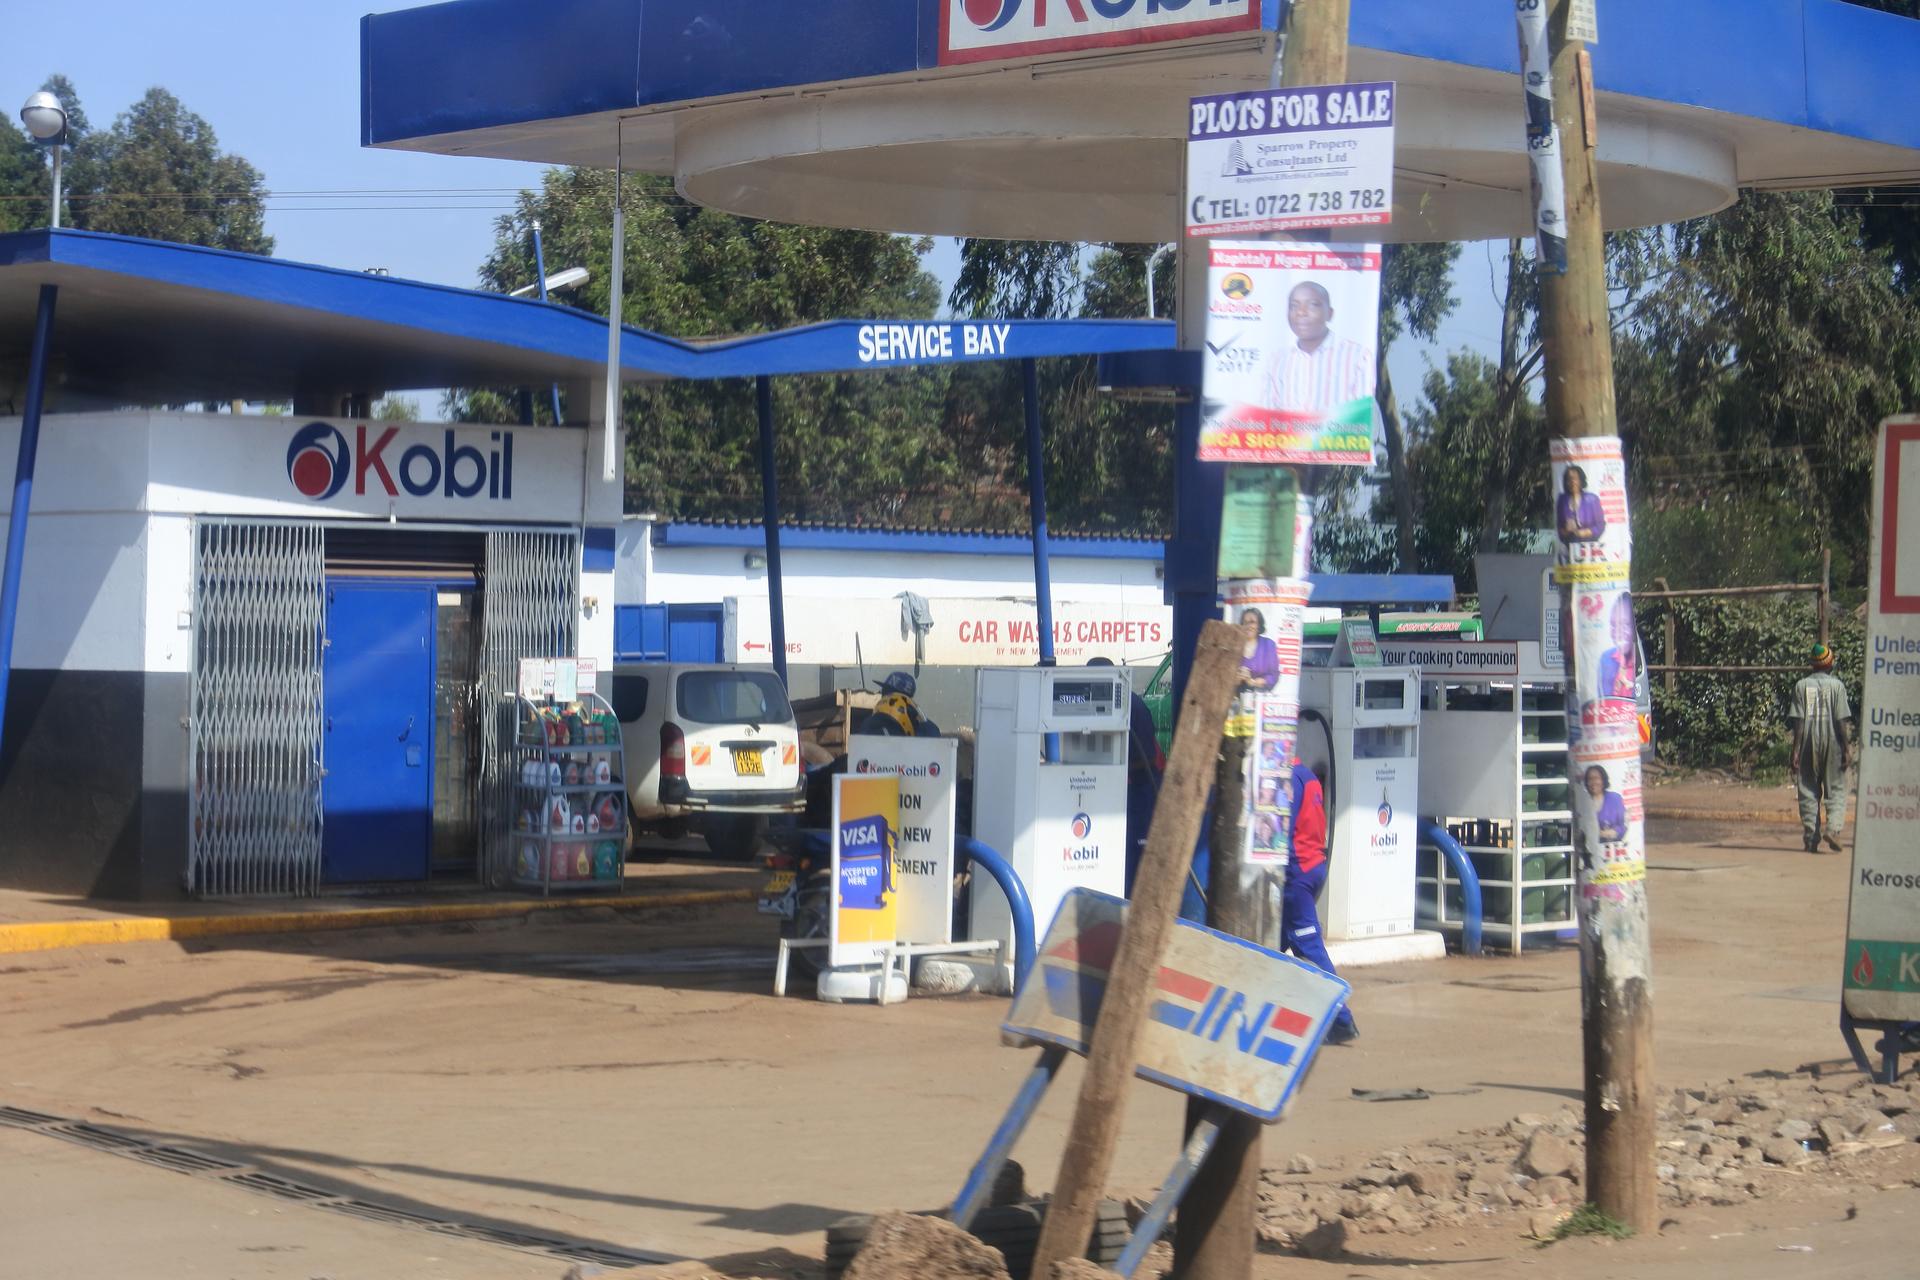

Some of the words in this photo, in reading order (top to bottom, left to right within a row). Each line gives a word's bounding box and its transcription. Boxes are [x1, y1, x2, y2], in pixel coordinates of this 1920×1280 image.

[1191, 98, 1266, 135] PLOTS
[1270, 94, 1321, 128] FOR
[1326, 90, 1391, 124] SALE
[1257, 141, 1304, 155] Sparrow
[1309, 138, 1358, 153] Property
[1256, 154, 1323, 168] Consultants
[1327, 152, 1348, 163] Ltd
[1209, 198, 1249, 220] TEL:
[1256, 194, 1301, 216] 0722
[1308, 191, 1342, 212] 738
[1350, 188, 1385, 209] 782
[1274, 254, 1312, 269] Ngugi
[858, 324, 953, 362] SERVICE
[963, 324, 1011, 356] BAY
[1319, 434, 1371, 450] WARD
[355, 424, 513, 500] Kobil
[959, 620, 998, 643] CAR
[1077, 621, 1161, 643] CARPETS
[996, 647, 1005, 656] BY
[1010, 647, 1026, 656] NEW
[1381, 649, 1407, 665] Your
[1409, 650, 1453, 668] Cooking
[1456, 650, 1517, 669] Companion
[1867, 784, 1894, 797] Low
[841, 824, 878, 847] VISA
[903, 826, 931, 843] NEW
[1371, 832, 1398, 847] Kobil
[1063, 845, 1099, 861] Kobil
[841, 865, 878, 877] ACCEPTED
[847, 876, 868, 886] HERE
